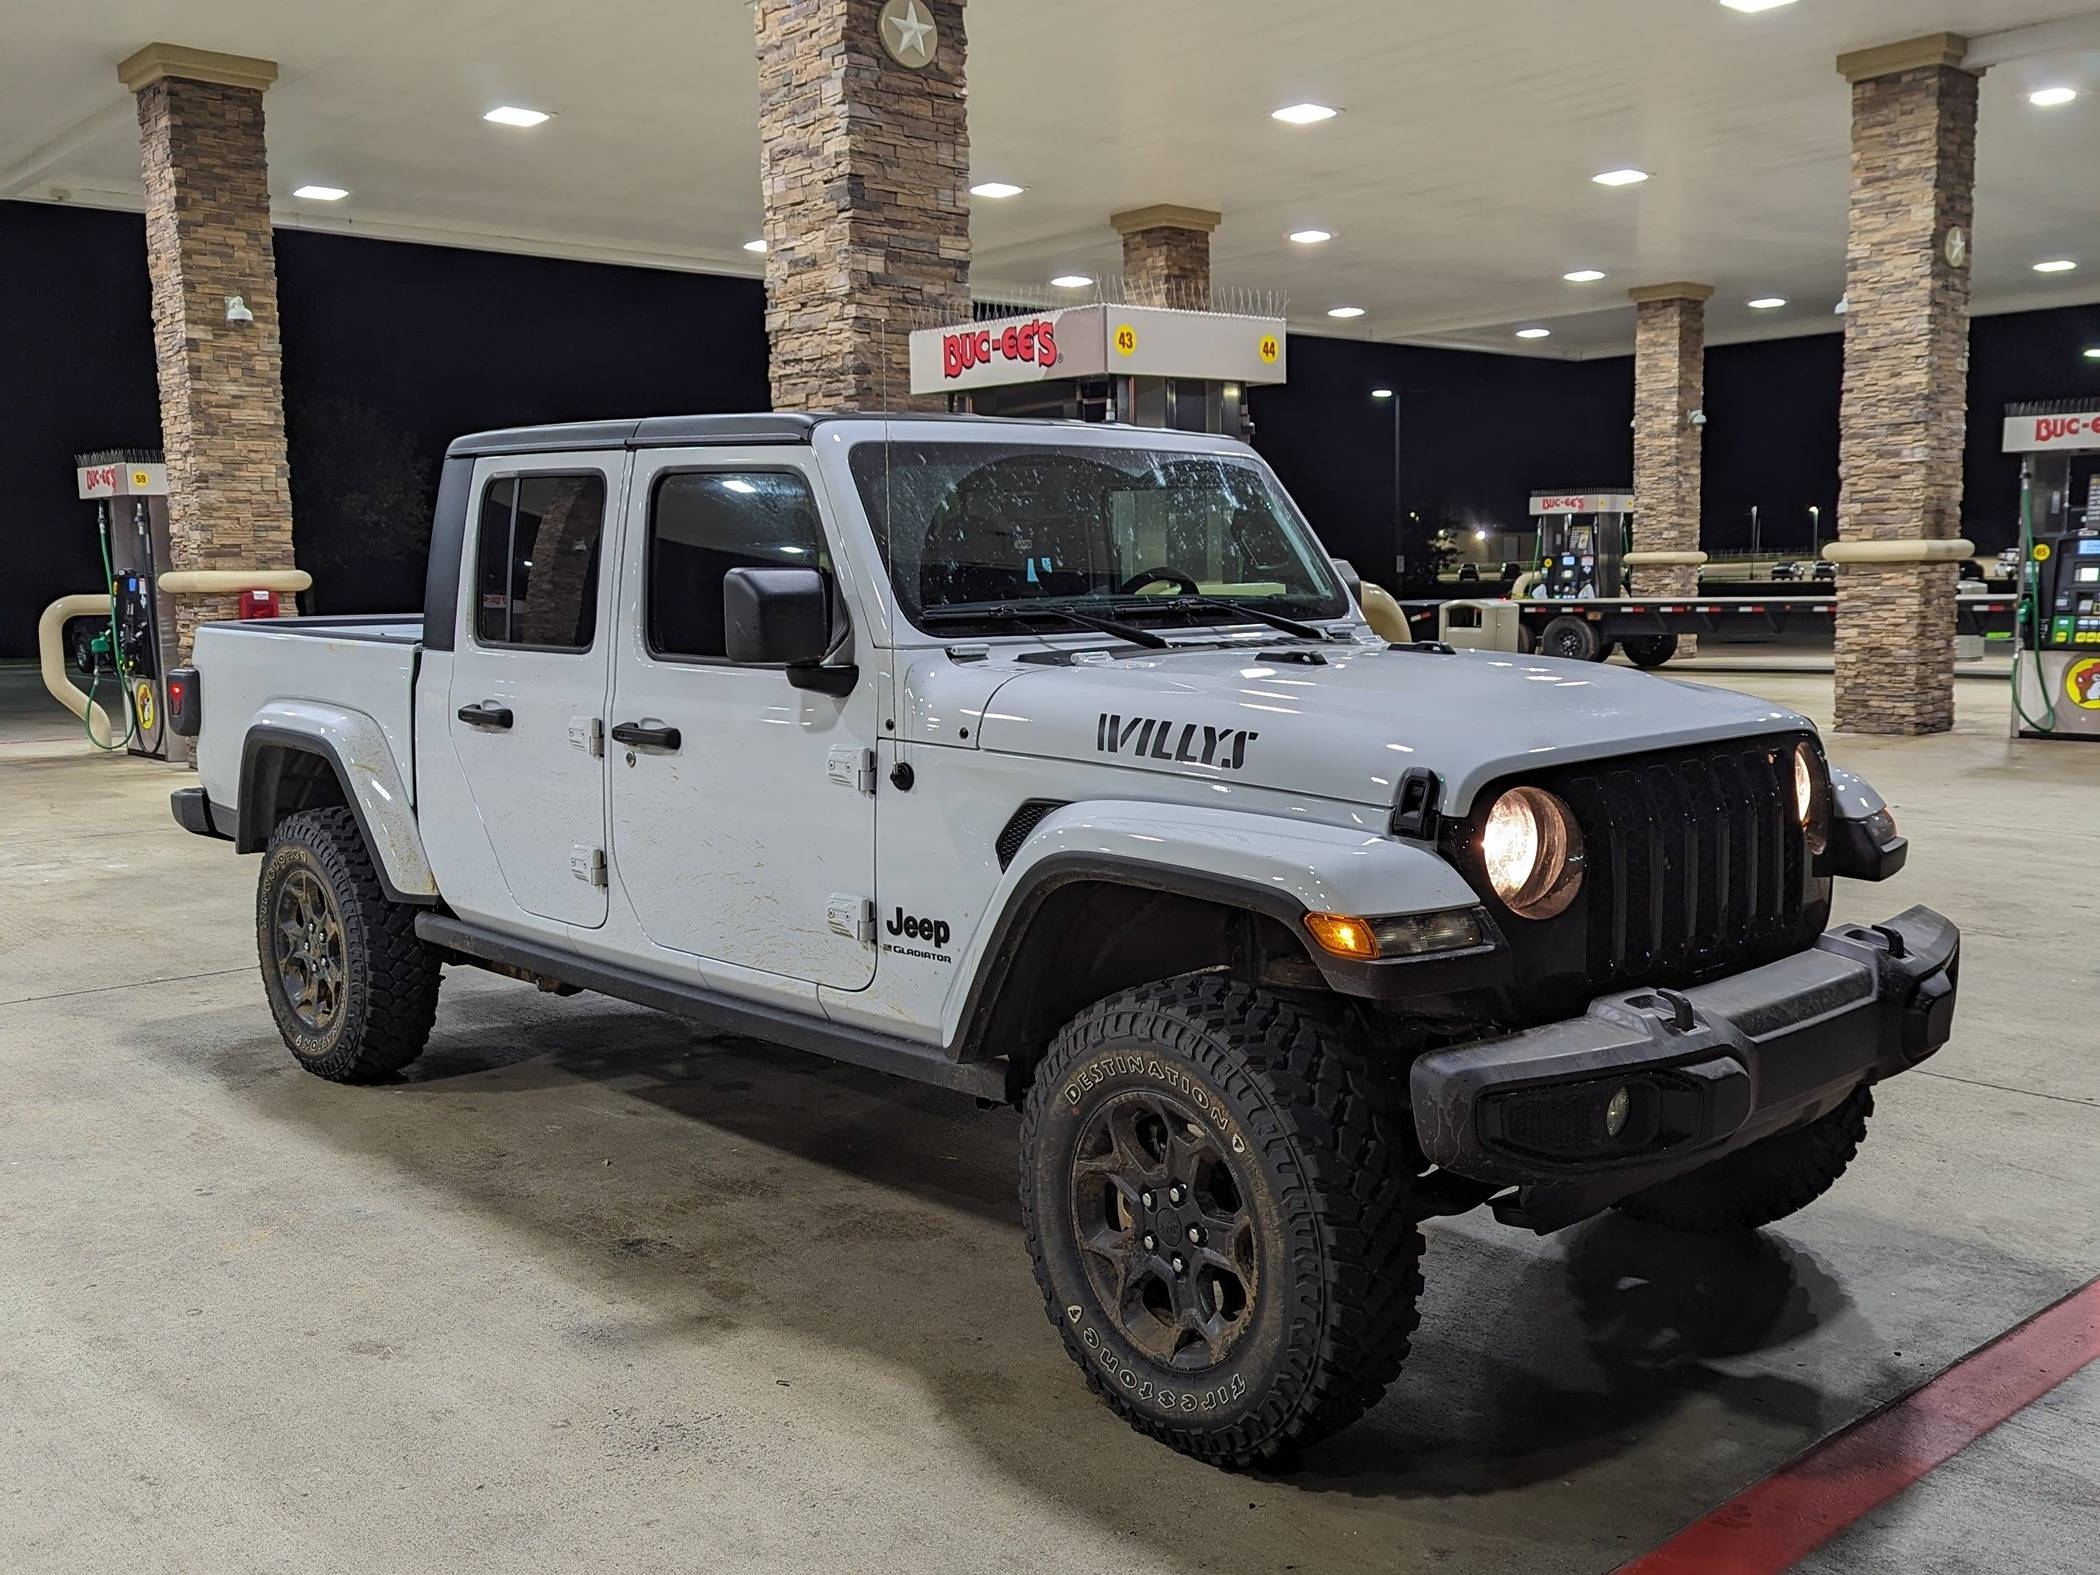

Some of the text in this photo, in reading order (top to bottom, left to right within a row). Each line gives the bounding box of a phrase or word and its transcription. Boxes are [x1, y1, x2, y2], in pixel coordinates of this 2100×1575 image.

[1118, 333, 1133, 351] 43
[1263, 341, 1276, 358] 44
[135, 474, 147, 484] 59
[1097, 712, 1259, 770] WILLYS
[886, 906, 950, 949] Jeep
[893, 945, 952, 964] GLADIATOR
[1065, 1056, 1229, 1131] DESTINATION
